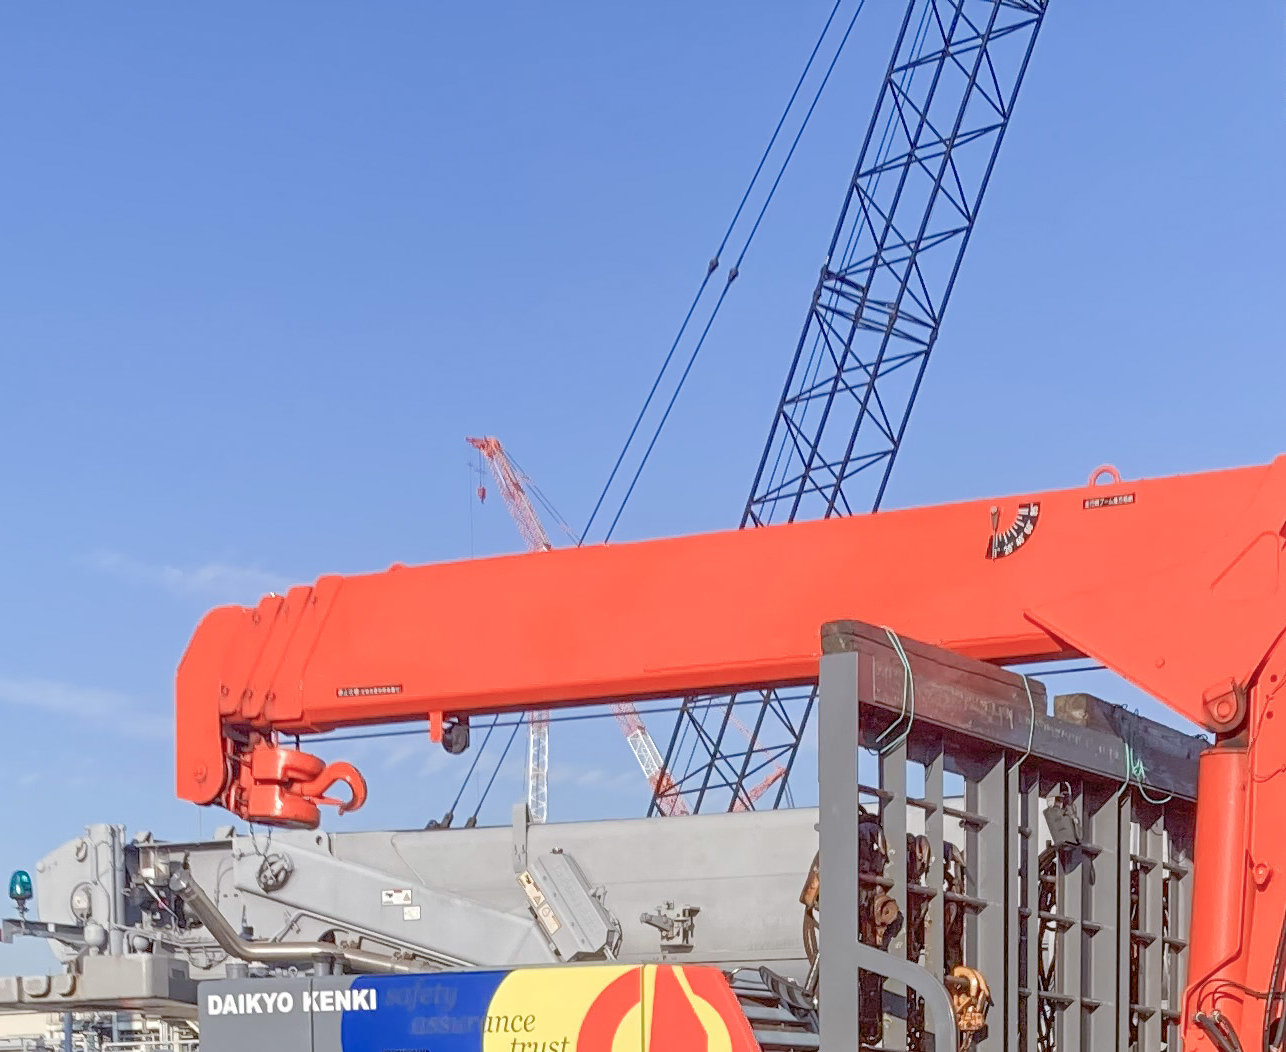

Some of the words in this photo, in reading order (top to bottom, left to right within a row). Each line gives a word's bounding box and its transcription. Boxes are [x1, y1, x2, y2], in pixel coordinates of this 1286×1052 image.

[207, 992, 294, 1016] DAIKYO
[302, 988, 377, 1013] KENKI
[411, 1014, 536, 1035] assurance
